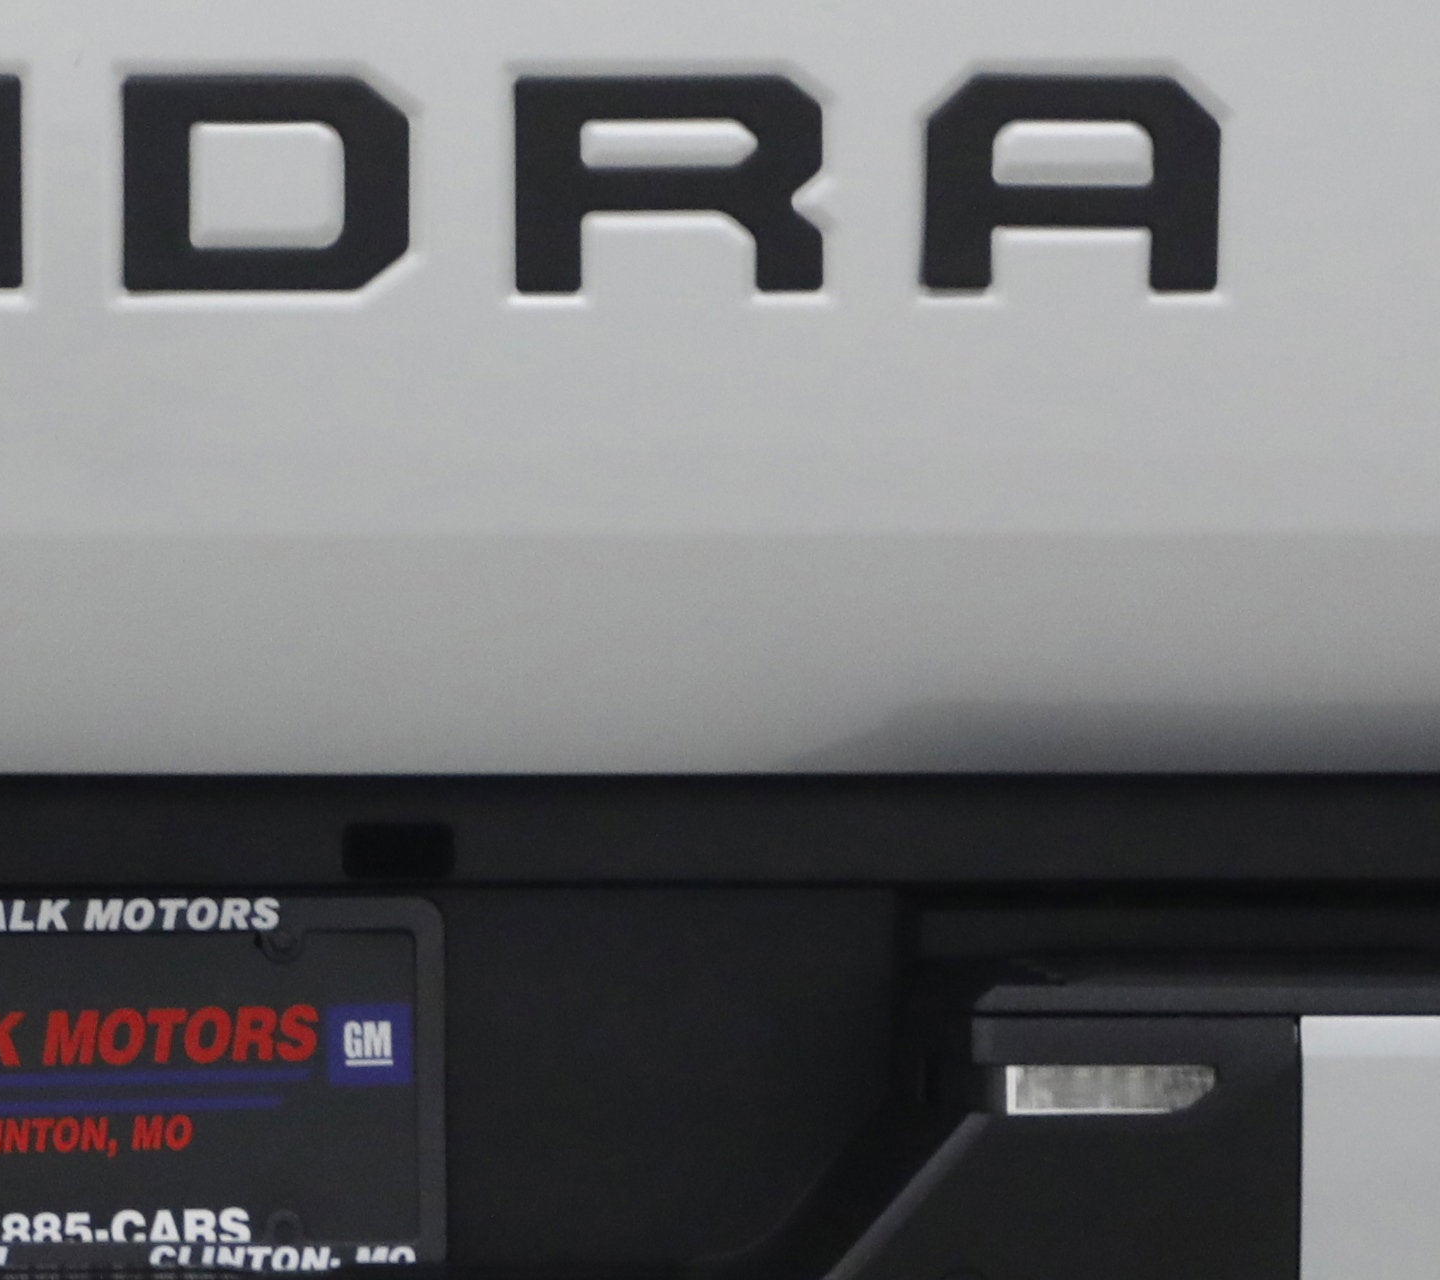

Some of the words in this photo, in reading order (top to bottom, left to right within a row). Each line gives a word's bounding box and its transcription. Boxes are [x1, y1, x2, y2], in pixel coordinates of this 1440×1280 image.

[83, 897, 280, 931] MOTORS
[42, 1004, 319, 1066] MOTORS
[343, 1020, 392, 1059] GM
[131, 1114, 194, 1151] MO
